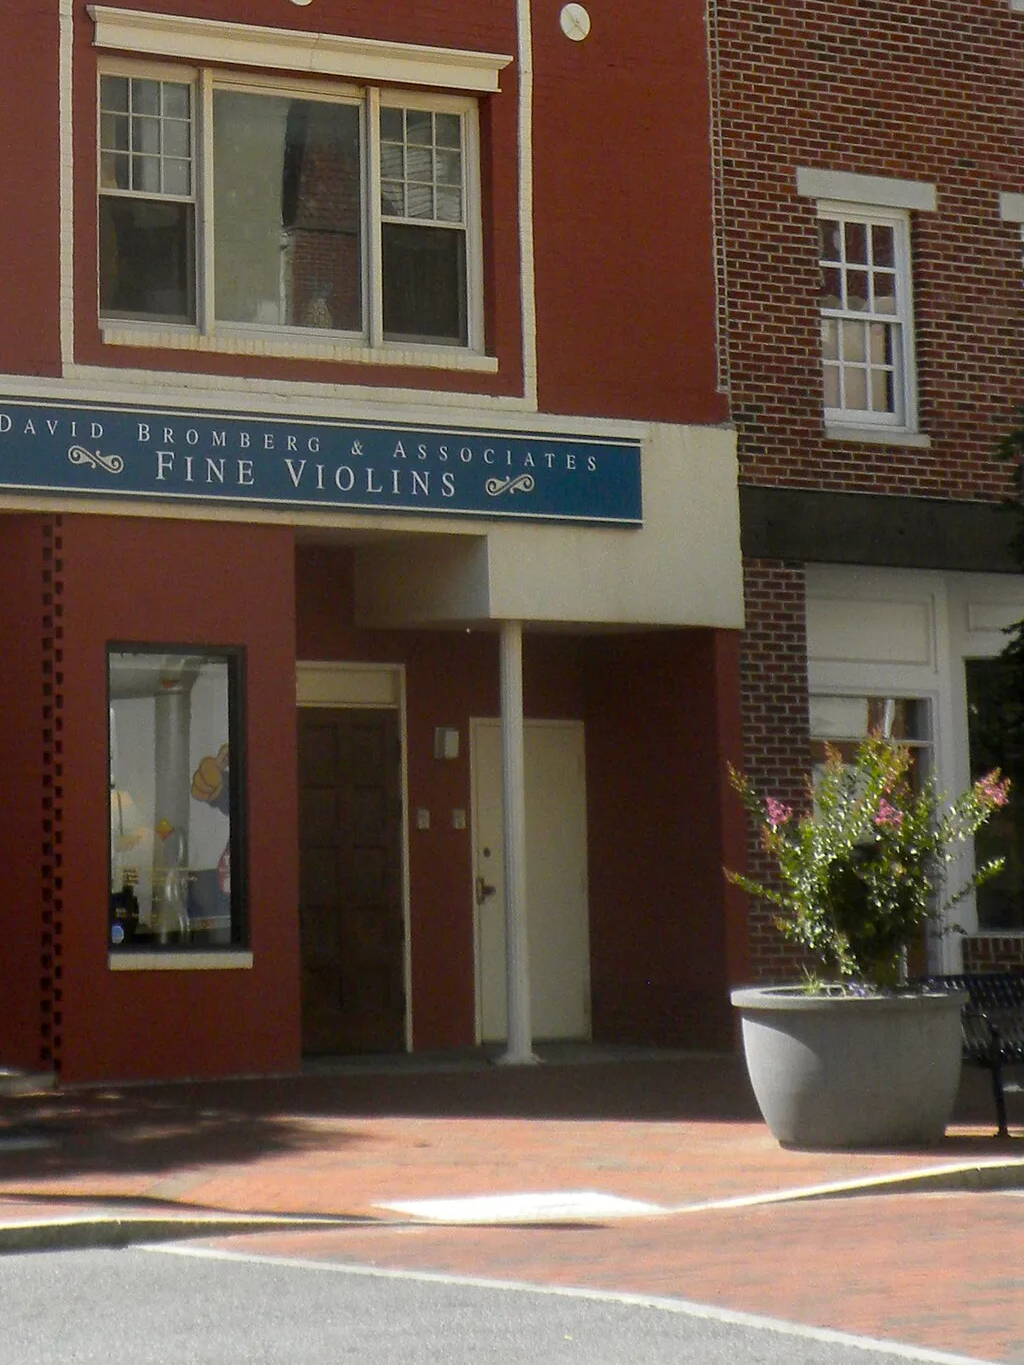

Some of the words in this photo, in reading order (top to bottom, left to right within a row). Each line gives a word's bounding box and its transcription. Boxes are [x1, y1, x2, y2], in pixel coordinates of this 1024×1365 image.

[137, 423, 321, 453] BROMBERG
[351, 439, 364, 456] &
[393, 440, 597, 472] ASSOCIATES
[155, 450, 255, 486] FINE
[284, 457, 456, 498] VIOLINS
